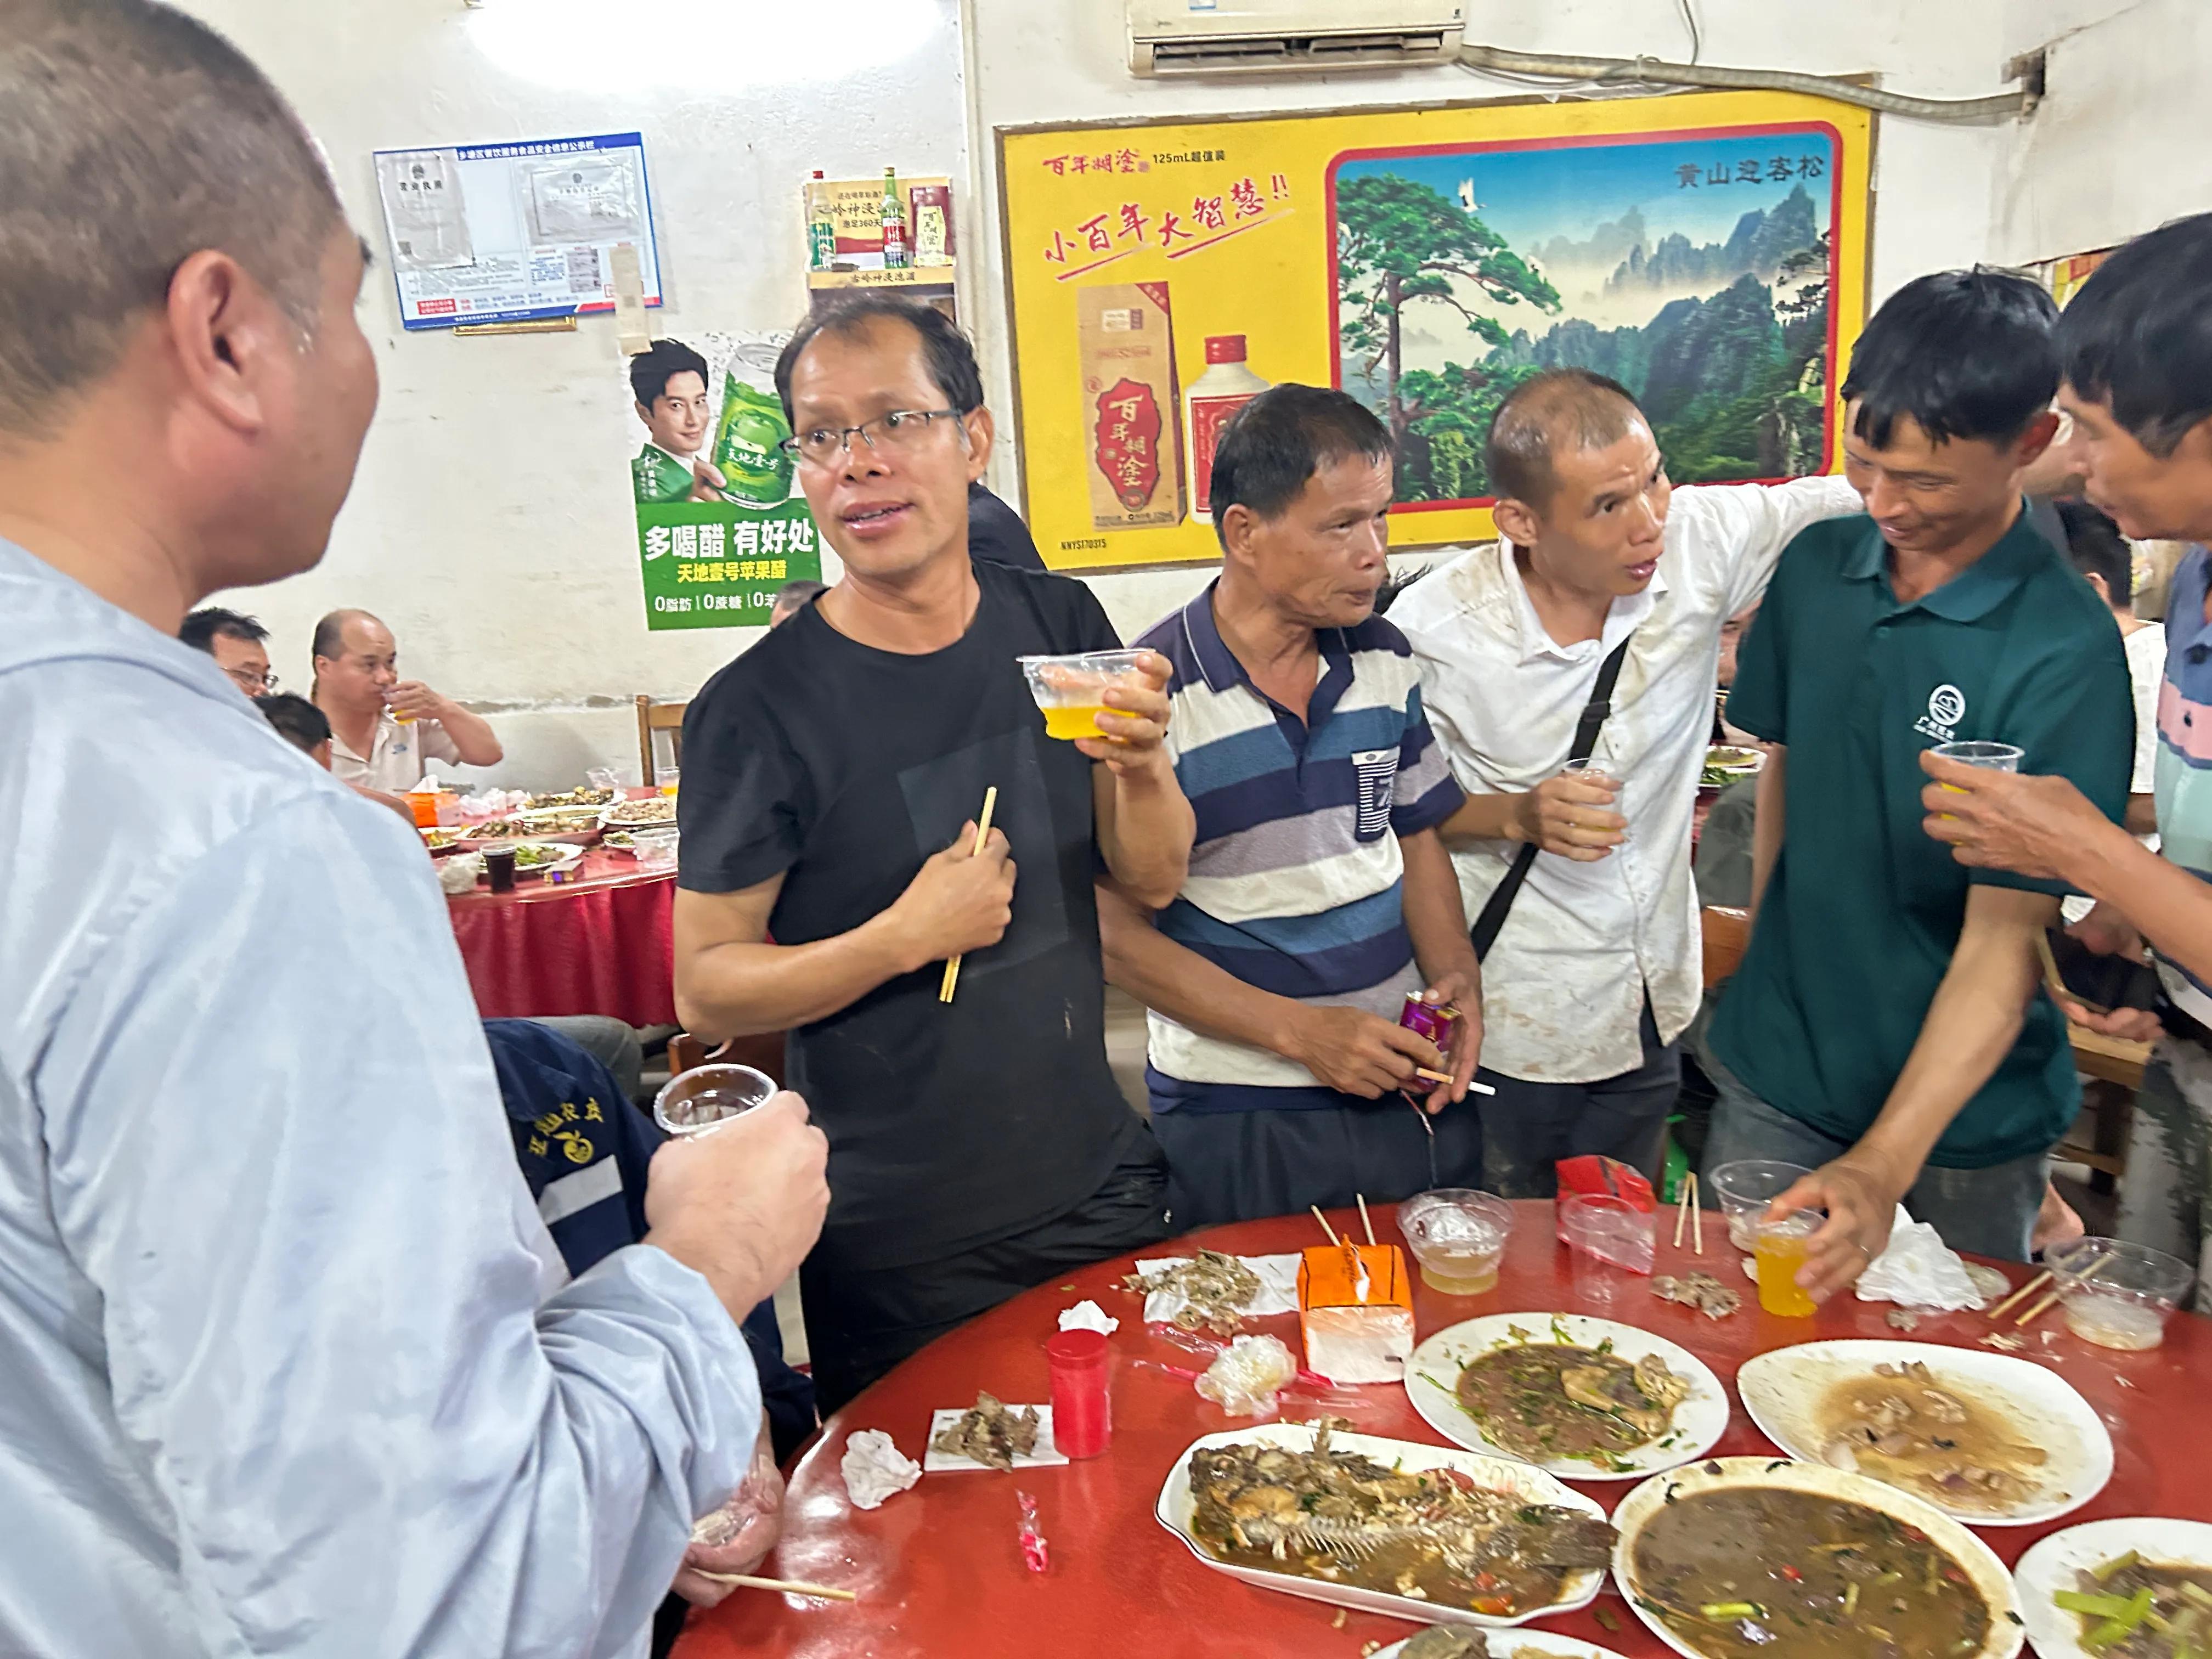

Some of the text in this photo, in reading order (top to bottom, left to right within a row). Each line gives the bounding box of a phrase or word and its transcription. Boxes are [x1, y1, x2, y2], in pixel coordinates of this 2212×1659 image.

[1675, 154, 1824, 189] 黄山迎客松
[645, 518, 815, 562] 多喝醋 有好处
[677, 559, 787, 584] 天地壹号苹果醋
